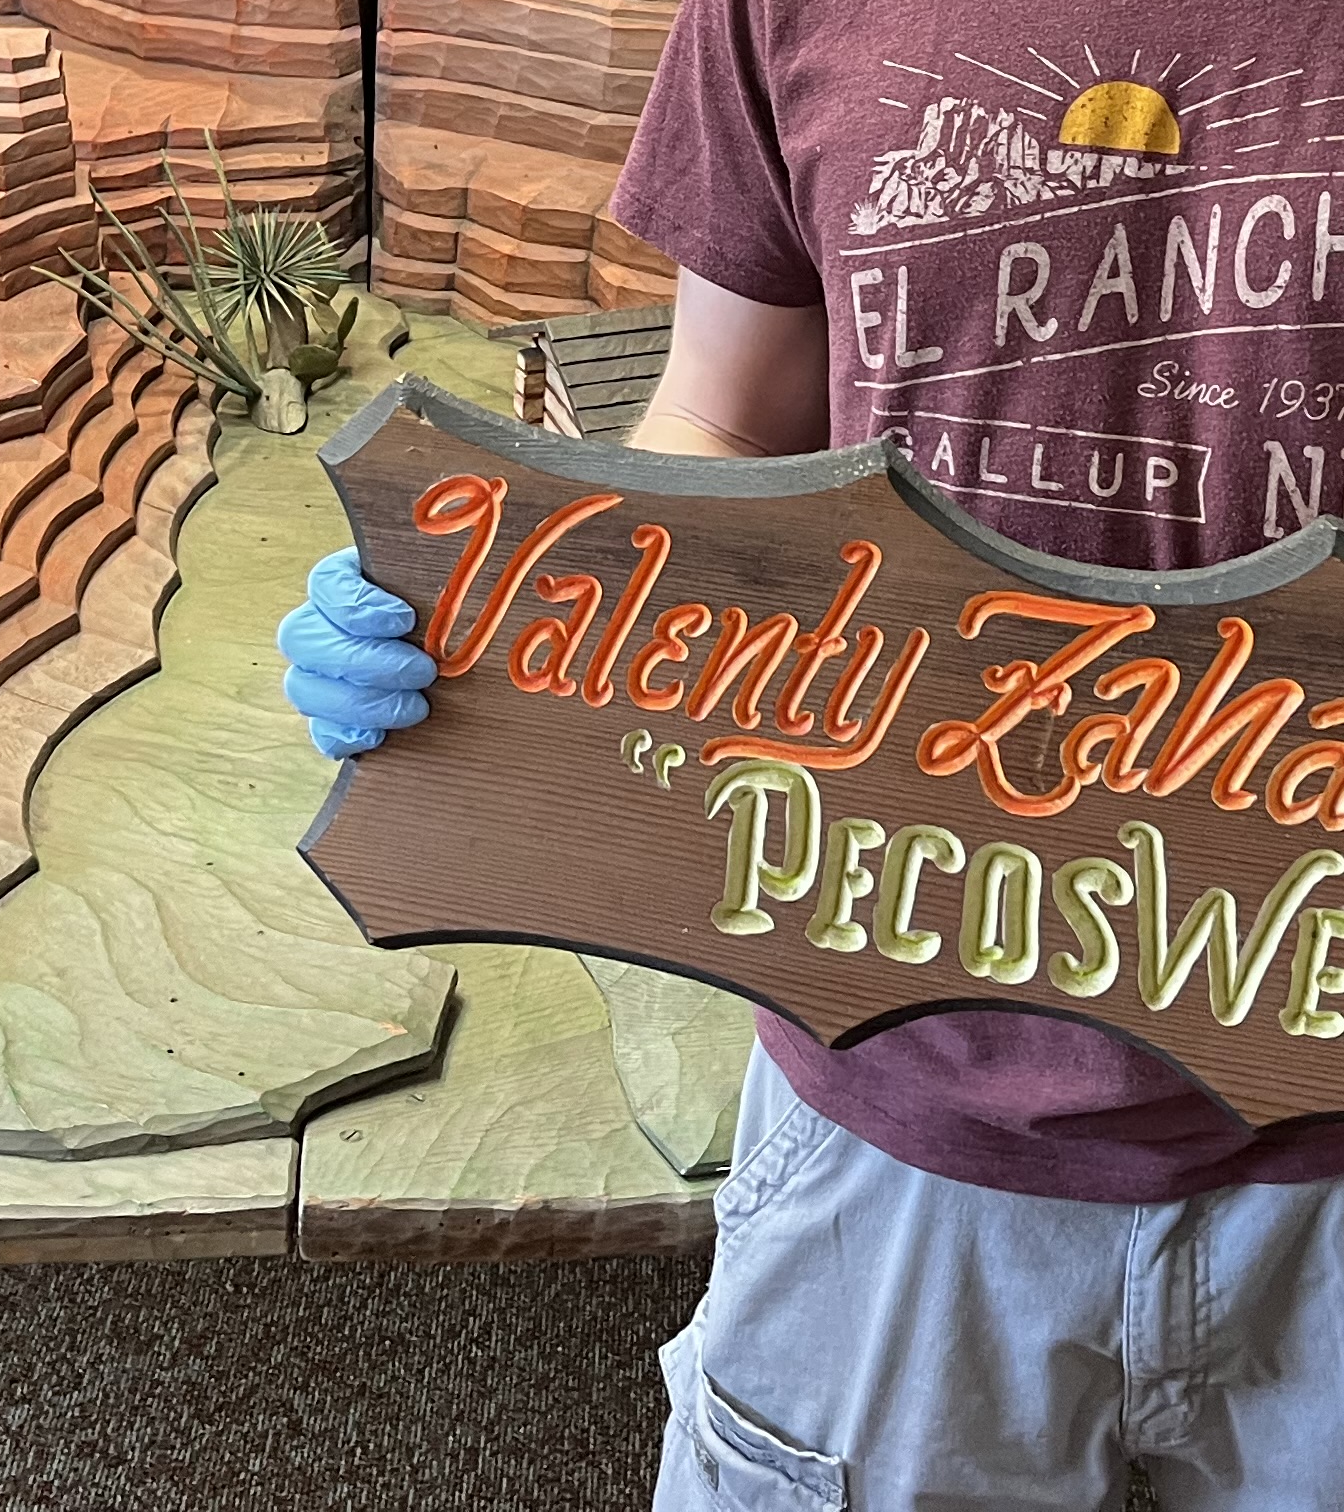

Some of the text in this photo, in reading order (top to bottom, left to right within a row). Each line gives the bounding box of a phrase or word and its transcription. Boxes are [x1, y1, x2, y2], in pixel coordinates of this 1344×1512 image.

[851, 266, 944, 369] EL
[1136, 359, 1240, 409] Since
[412, 474, 930, 770] Valenty
